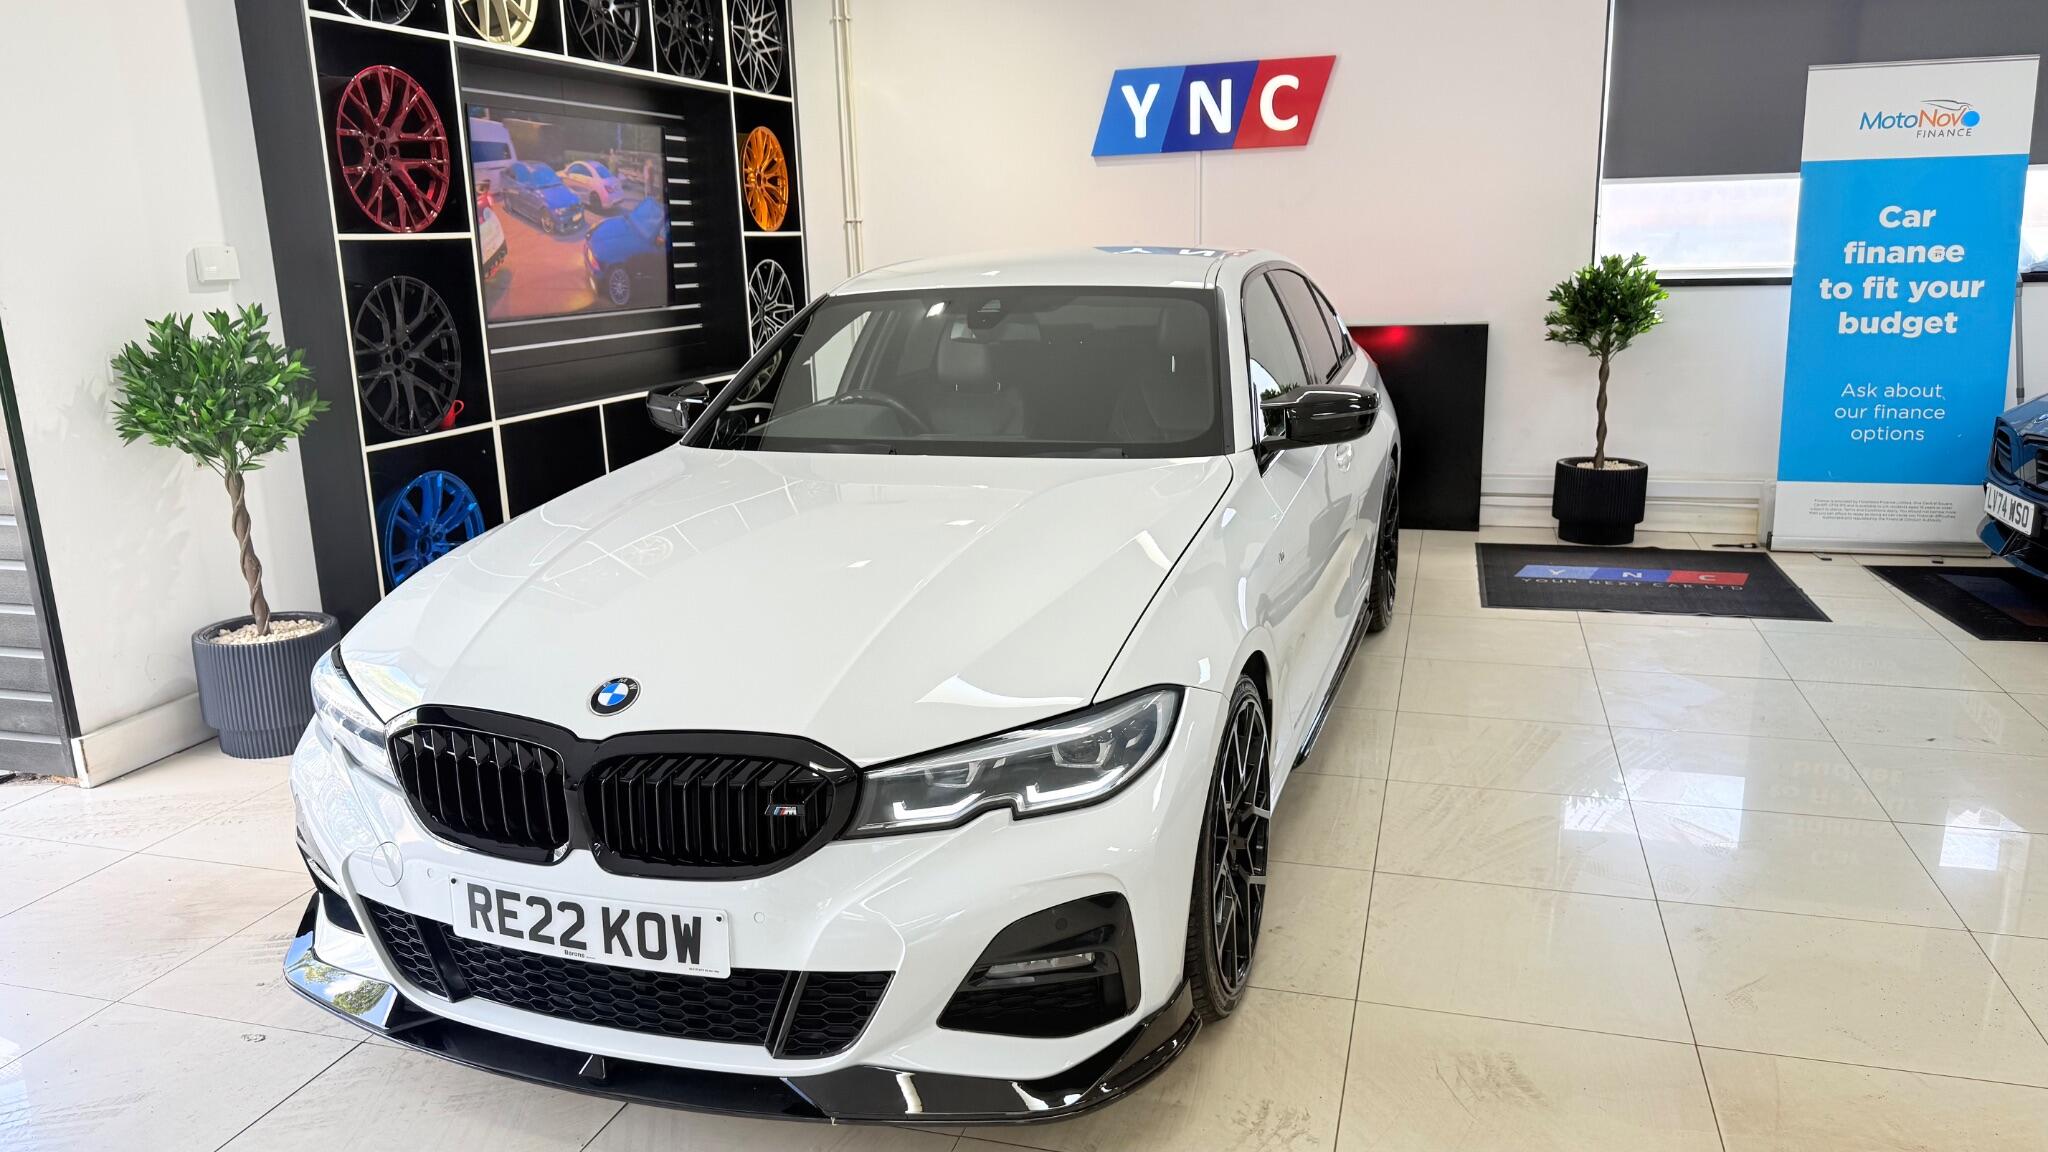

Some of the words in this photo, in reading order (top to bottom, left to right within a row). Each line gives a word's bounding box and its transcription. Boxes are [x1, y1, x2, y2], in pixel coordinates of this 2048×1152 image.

[1121, 74, 1300, 138] YNC
[1916, 128, 1972, 138] FINANCE
[1879, 205, 1937, 228] Car
[1844, 241, 1965, 264] finance
[1819, 278, 1853, 299] to
[1862, 276, 1898, 299] fit
[1909, 279, 1985, 303] your
[1838, 311, 1958, 338] budget
[1841, 383, 1877, 398] Ask
[1884, 383, 1943, 398] about
[1834, 406, 1867, 420] our
[1874, 404, 1946, 420] finance
[1850, 427, 1925, 443] options
[1986, 487, 2008, 517] LV74
[2008, 498, 2030, 528] WSO
[467, 883, 587, 950] RE22
[601, 906, 701, 965] KOW
